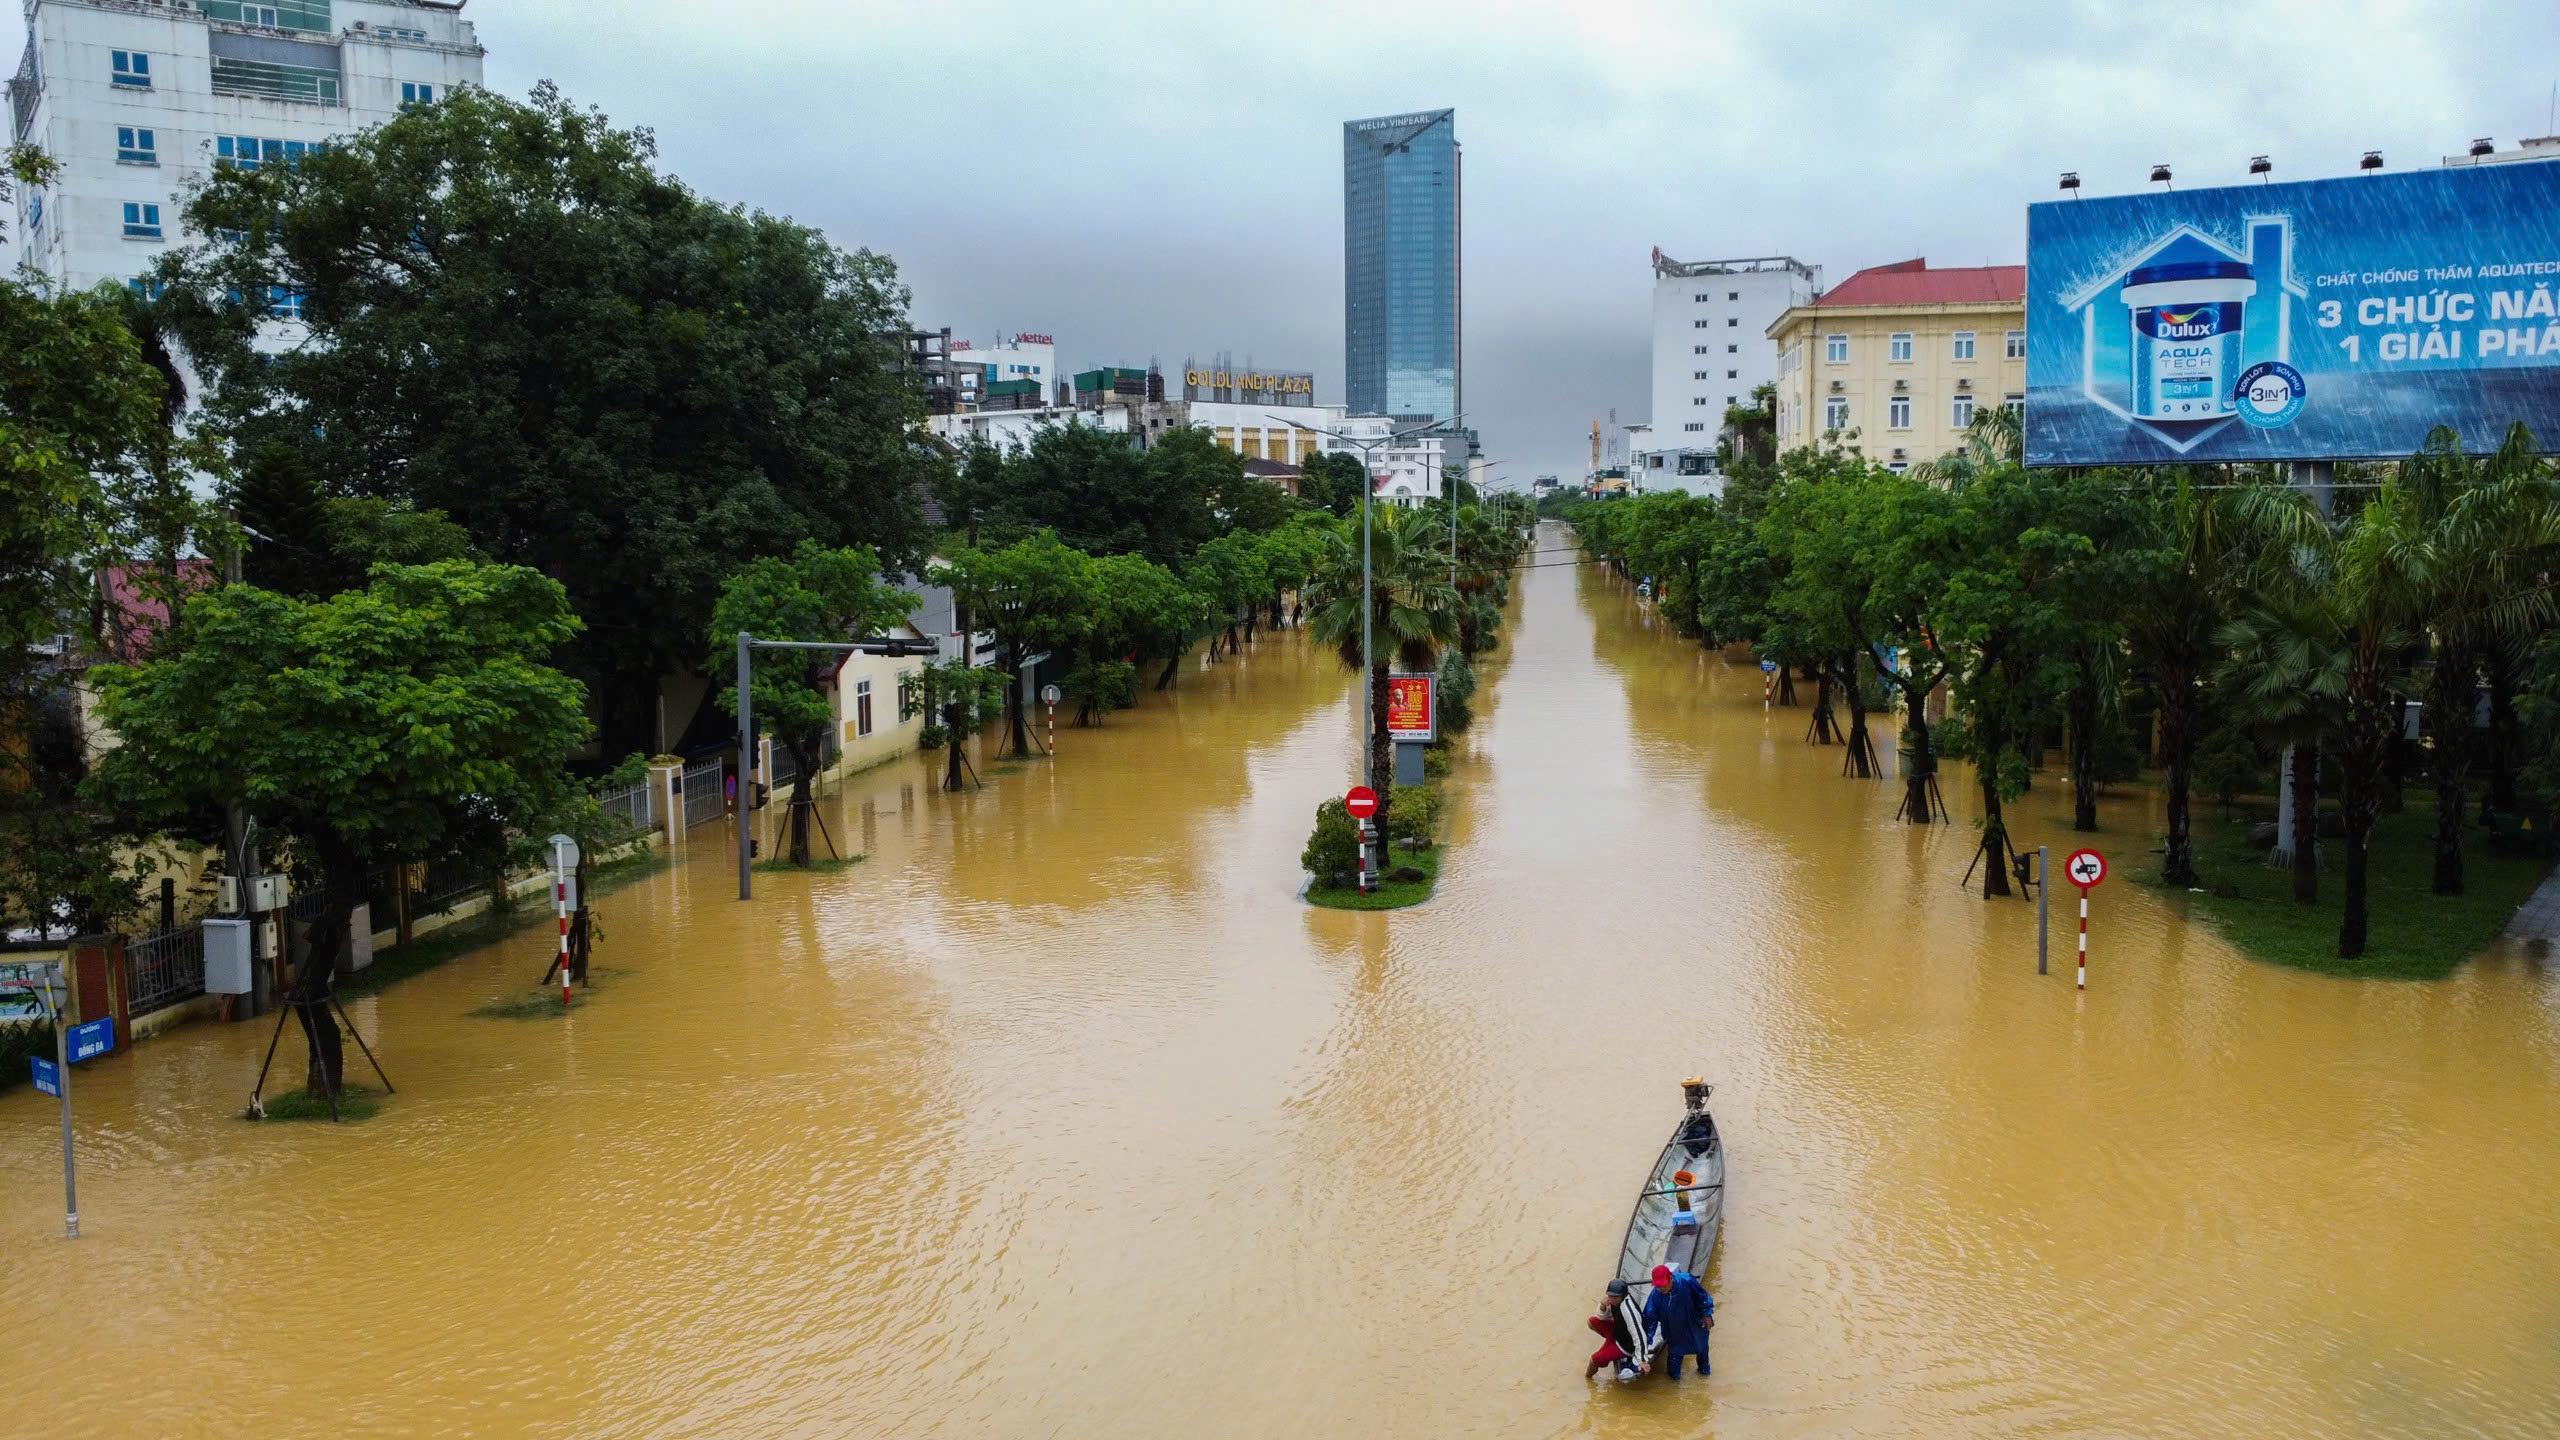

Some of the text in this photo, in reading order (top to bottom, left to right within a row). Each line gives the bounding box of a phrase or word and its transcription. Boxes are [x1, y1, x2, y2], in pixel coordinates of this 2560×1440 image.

[1390, 115, 1430, 128] VINPEARL
[2316, 269, 2357, 287] CHẤT
[2362, 266, 2419, 285] CHỐNG
[2424, 264, 2472, 281] THẤM
[2318, 281, 2560, 328] 3 CHỨC NĂ
[2158, 322, 2212, 338] Dulux
[2338, 335, 2360, 363] 1
[2378, 323, 2461, 361] GIẢI
[2159, 347, 2213, 359] AQUA
[2161, 358, 2211, 368] TECH
[1186, 368, 1311, 393] GOLDLAND PLAZA
